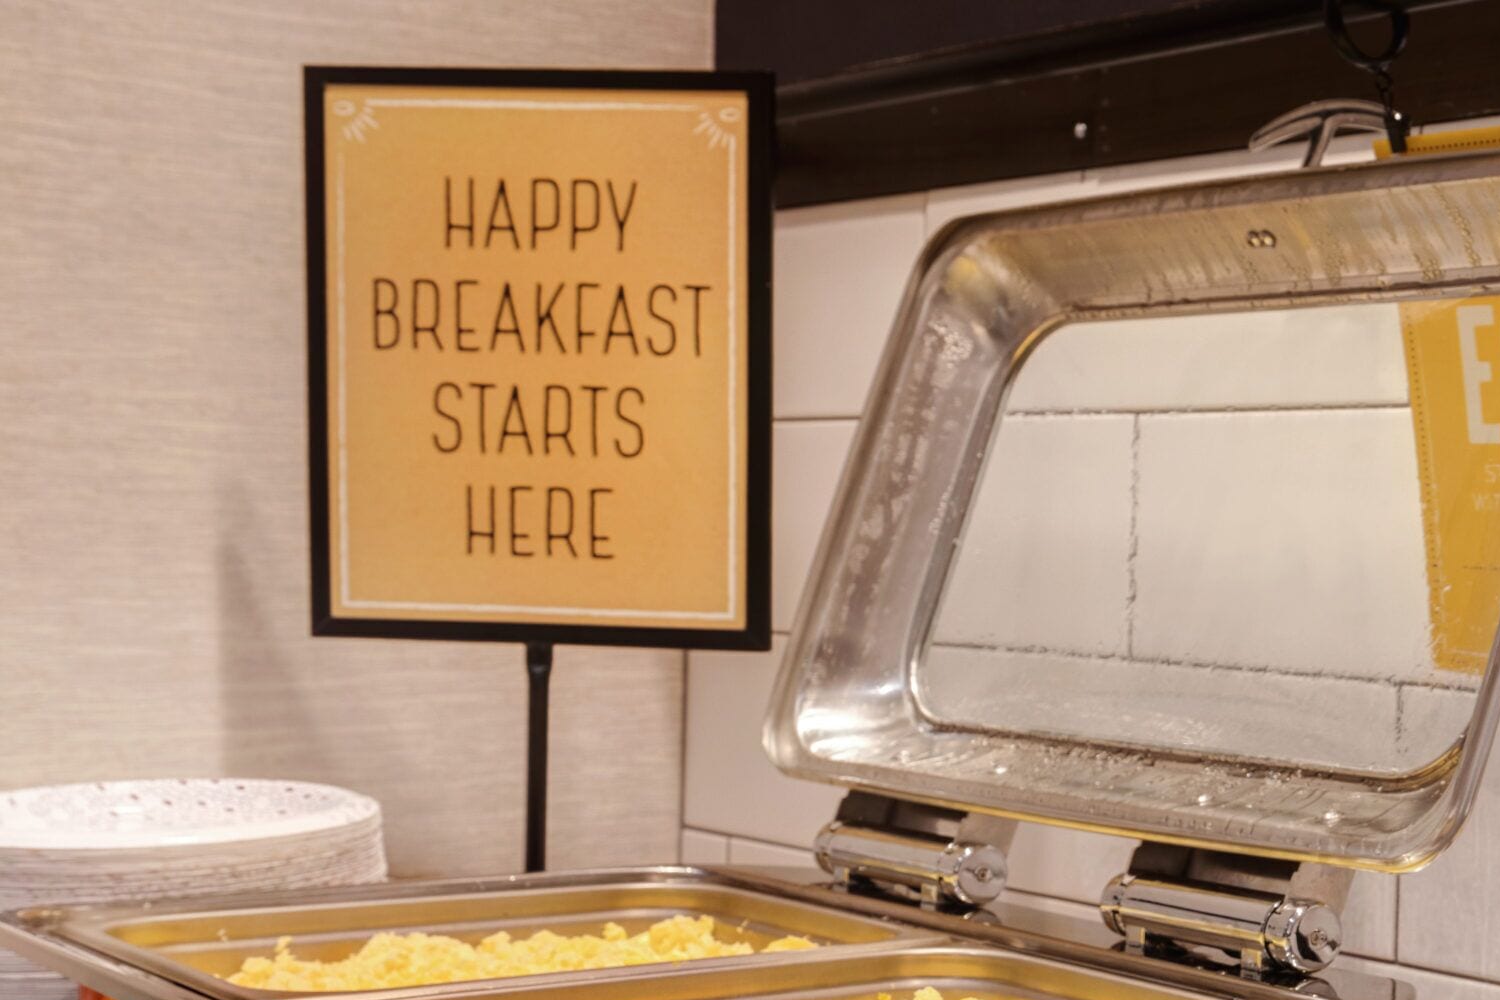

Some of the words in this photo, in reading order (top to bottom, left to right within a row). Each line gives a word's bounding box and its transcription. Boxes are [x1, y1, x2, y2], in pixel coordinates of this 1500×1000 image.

[444, 176, 638, 253] HAPPY
[371, 277, 712, 357] BREAKFAST
[432, 381, 646, 459] STARTS
[465, 484, 615, 560] HERE
